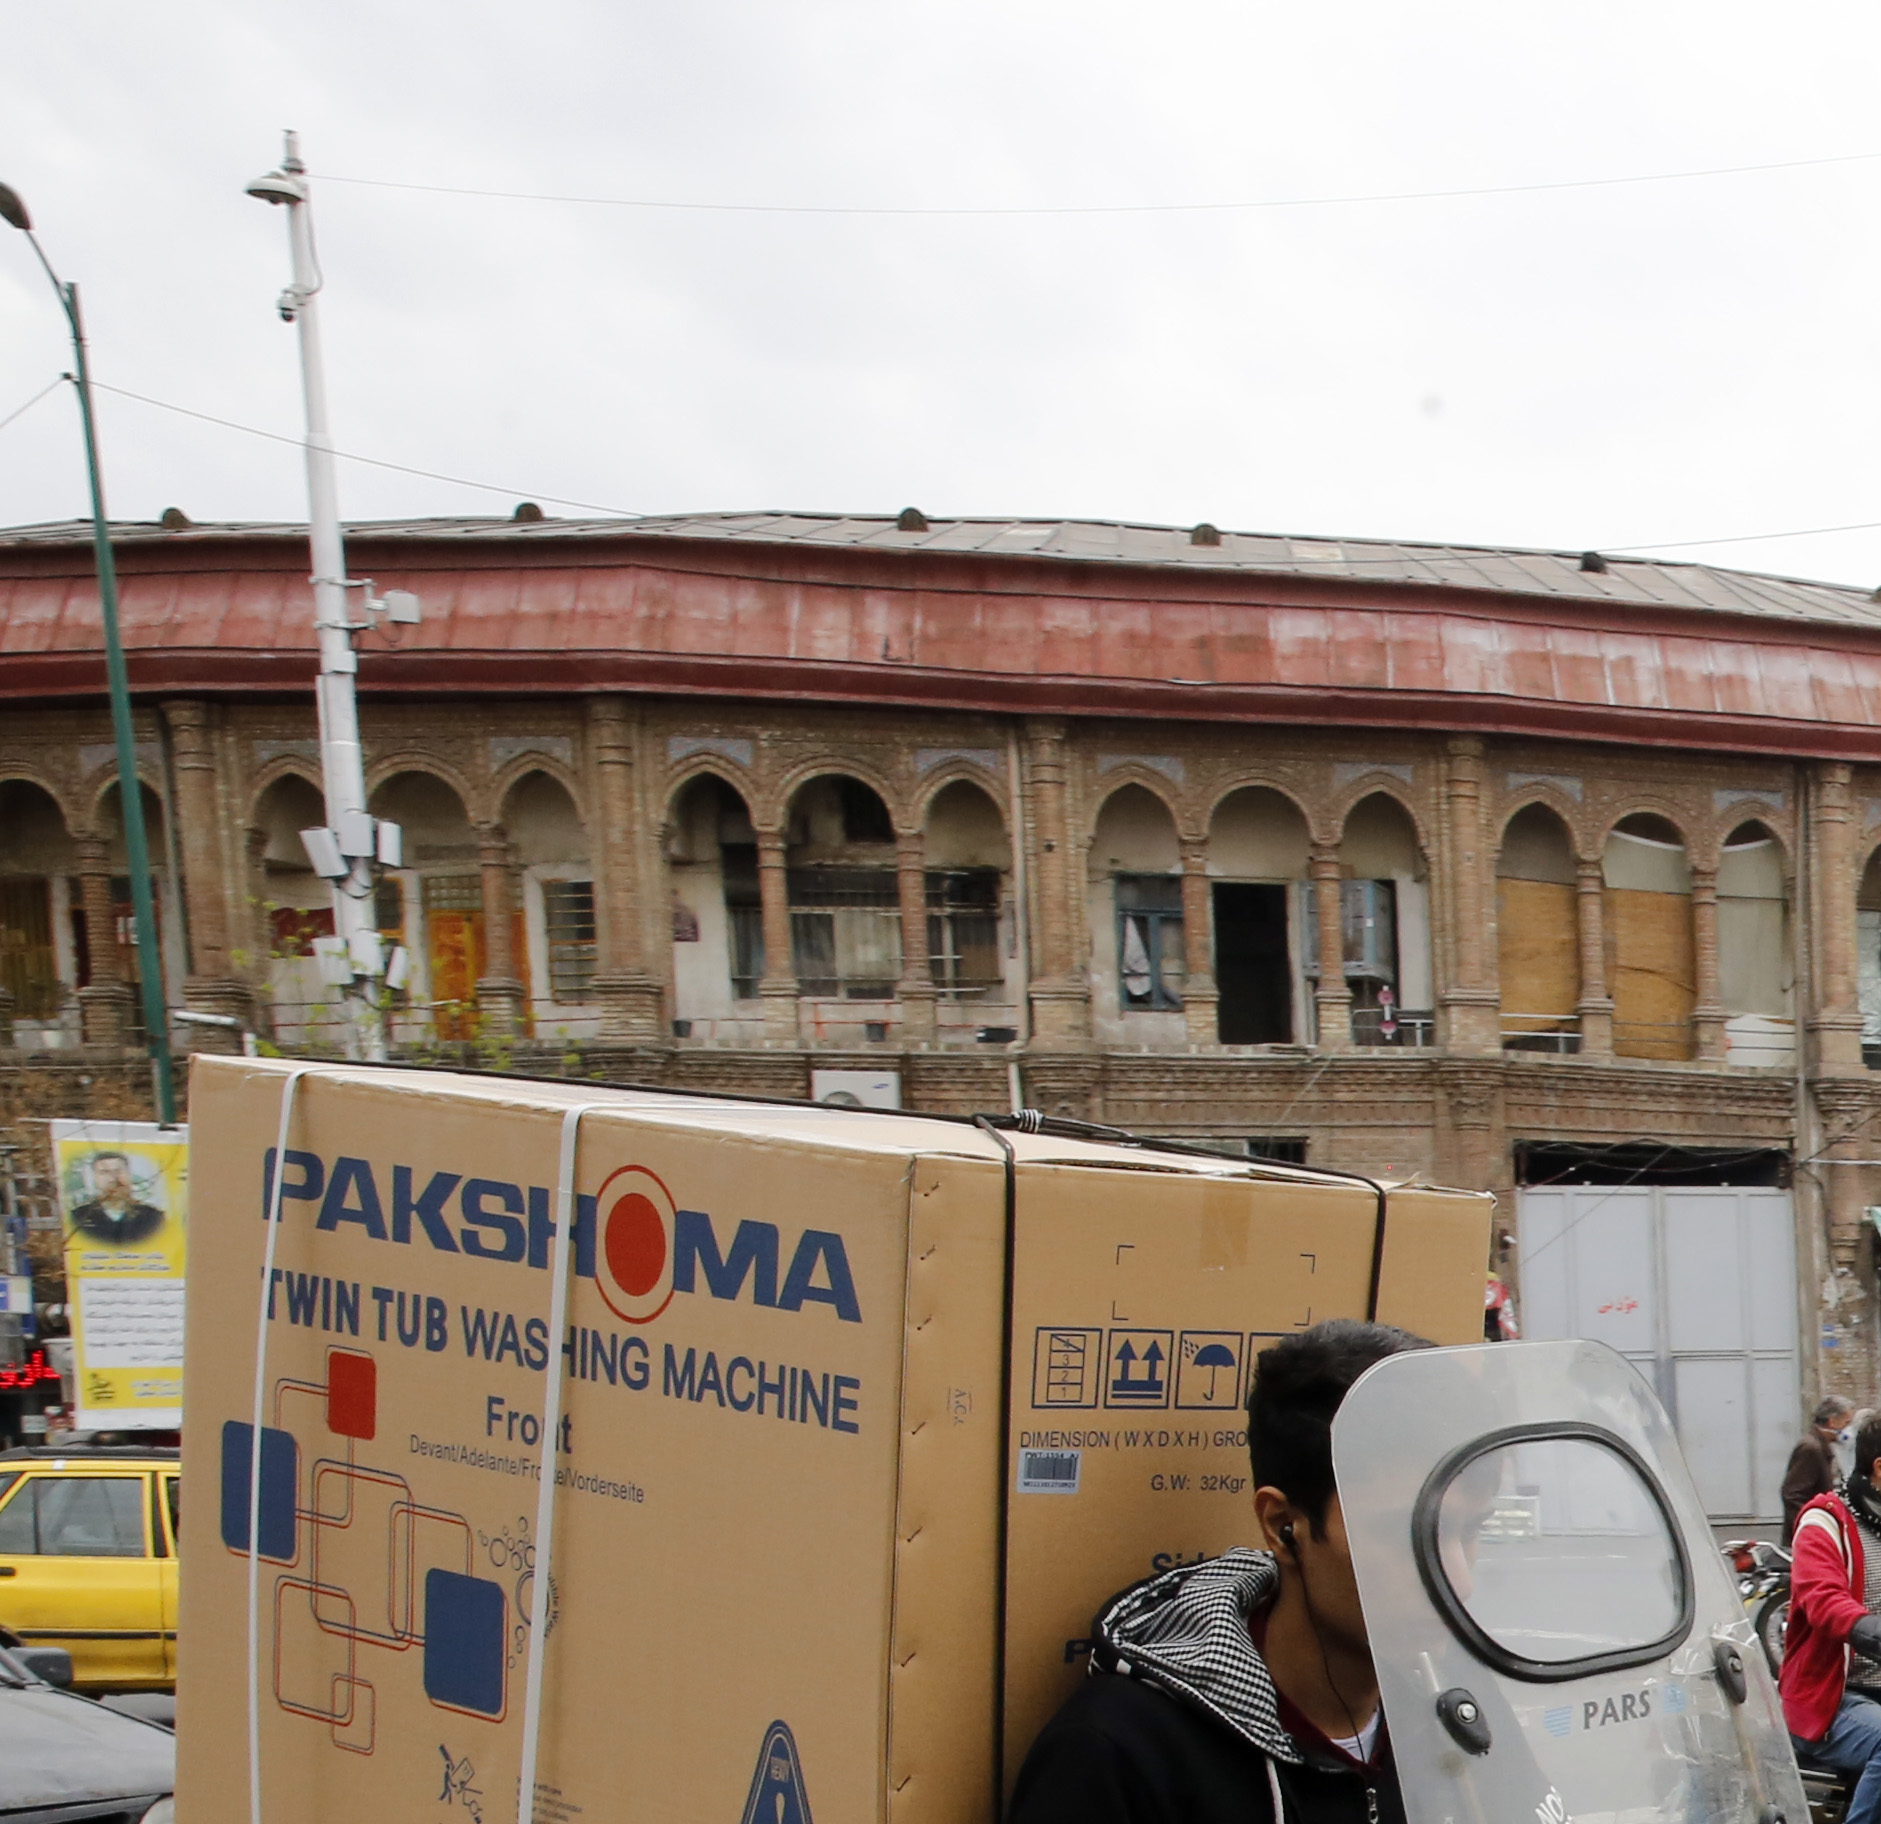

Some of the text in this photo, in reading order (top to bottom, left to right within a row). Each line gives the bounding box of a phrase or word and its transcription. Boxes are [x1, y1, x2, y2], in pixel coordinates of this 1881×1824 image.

[261, 1266, 362, 1336] TWIN
[372, 1285, 449, 1354] TUB
[461, 1304, 652, 1392] WASHING
[663, 1344, 862, 1435] MACHINE
[1020, 1431, 1110, 1448] DIMENSION
[1213, 1432, 1250, 1447] GRO
[409, 1433, 645, 1504] Devant/Adelante/Froe/Vorderseite
[1151, 1474, 1247, 1494] G.W: 32Kgr
[1583, 1691, 1652, 1732] PARS
